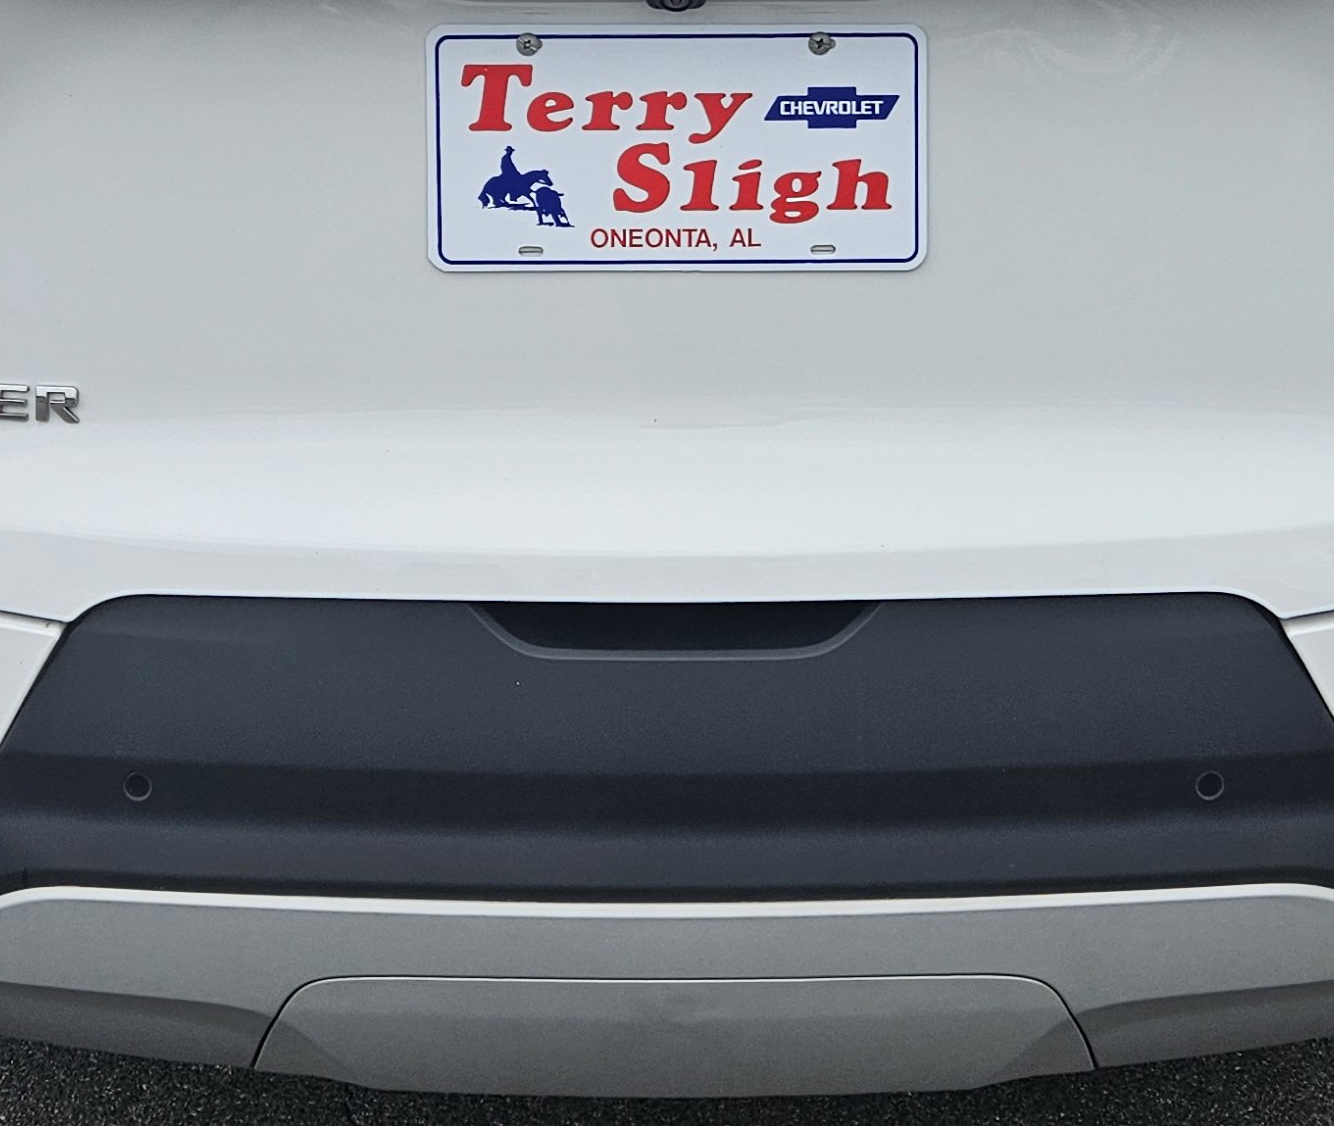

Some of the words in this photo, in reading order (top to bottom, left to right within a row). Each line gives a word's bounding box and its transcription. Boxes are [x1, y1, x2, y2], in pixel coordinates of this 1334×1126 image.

[461, 64, 753, 143] Terry
[779, 100, 885, 116] CHEVROLET
[612, 141, 892, 224] Sligh
[590, 227, 719, 251] ONEONTA,
[729, 228, 762, 248] AL
